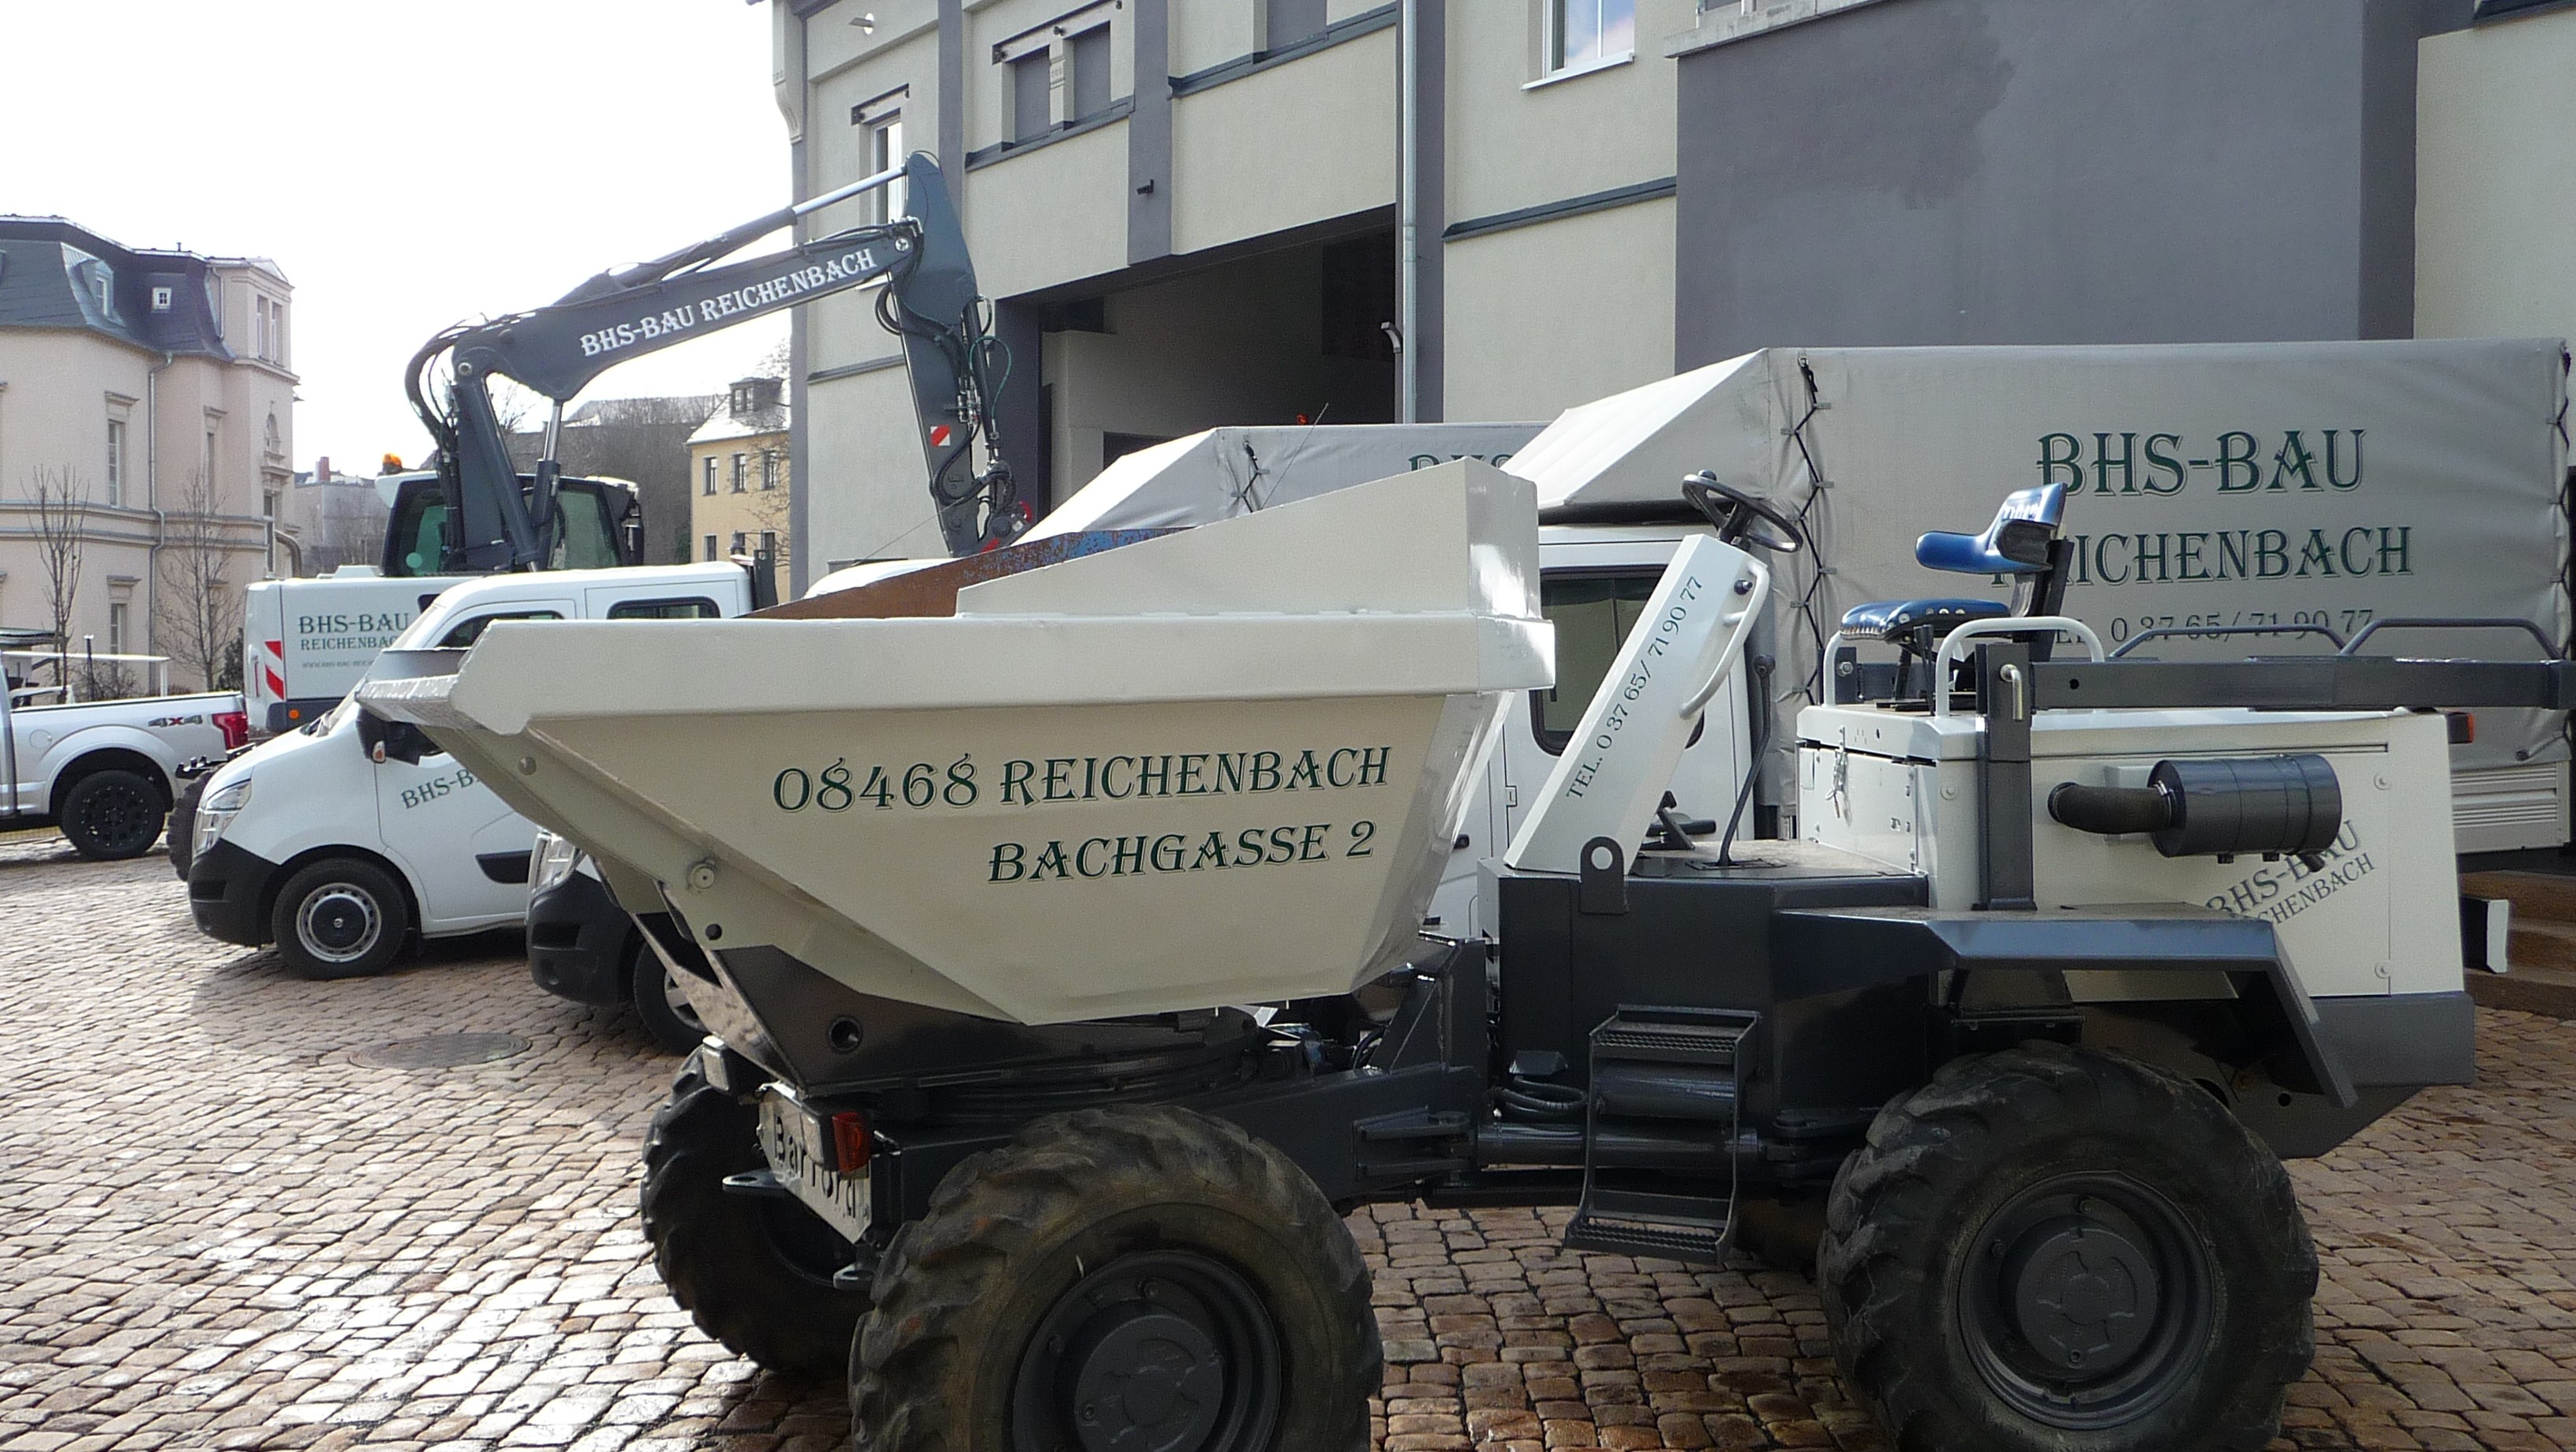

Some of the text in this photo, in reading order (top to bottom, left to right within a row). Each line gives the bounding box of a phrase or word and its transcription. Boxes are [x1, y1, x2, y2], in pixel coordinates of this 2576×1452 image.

[579, 249, 878, 357] BHS-BAU REICHENBACH
[2036, 428, 2367, 497] BHS-BAU
[1990, 526, 2414, 588] ICHENBACH
[298, 612, 409, 634] BHS-BAU
[301, 635, 399, 651] REICHENBAC
[1565, 757, 1604, 799] TEL.
[1606, 703, 1628, 731] 37
[1647, 637, 1670, 658] 71
[1662, 606, 1687, 634] 90
[1679, 575, 1703, 602] 77
[401, 769, 474, 809] BHS-B
[773, 746, 1393, 813] 08468 REICHENBACH
[987, 820, 1378, 883] BACHGASSE 2
[2205, 819, 2361, 918] BHS-BU
[2256, 852, 2376, 926] CHENBACH
